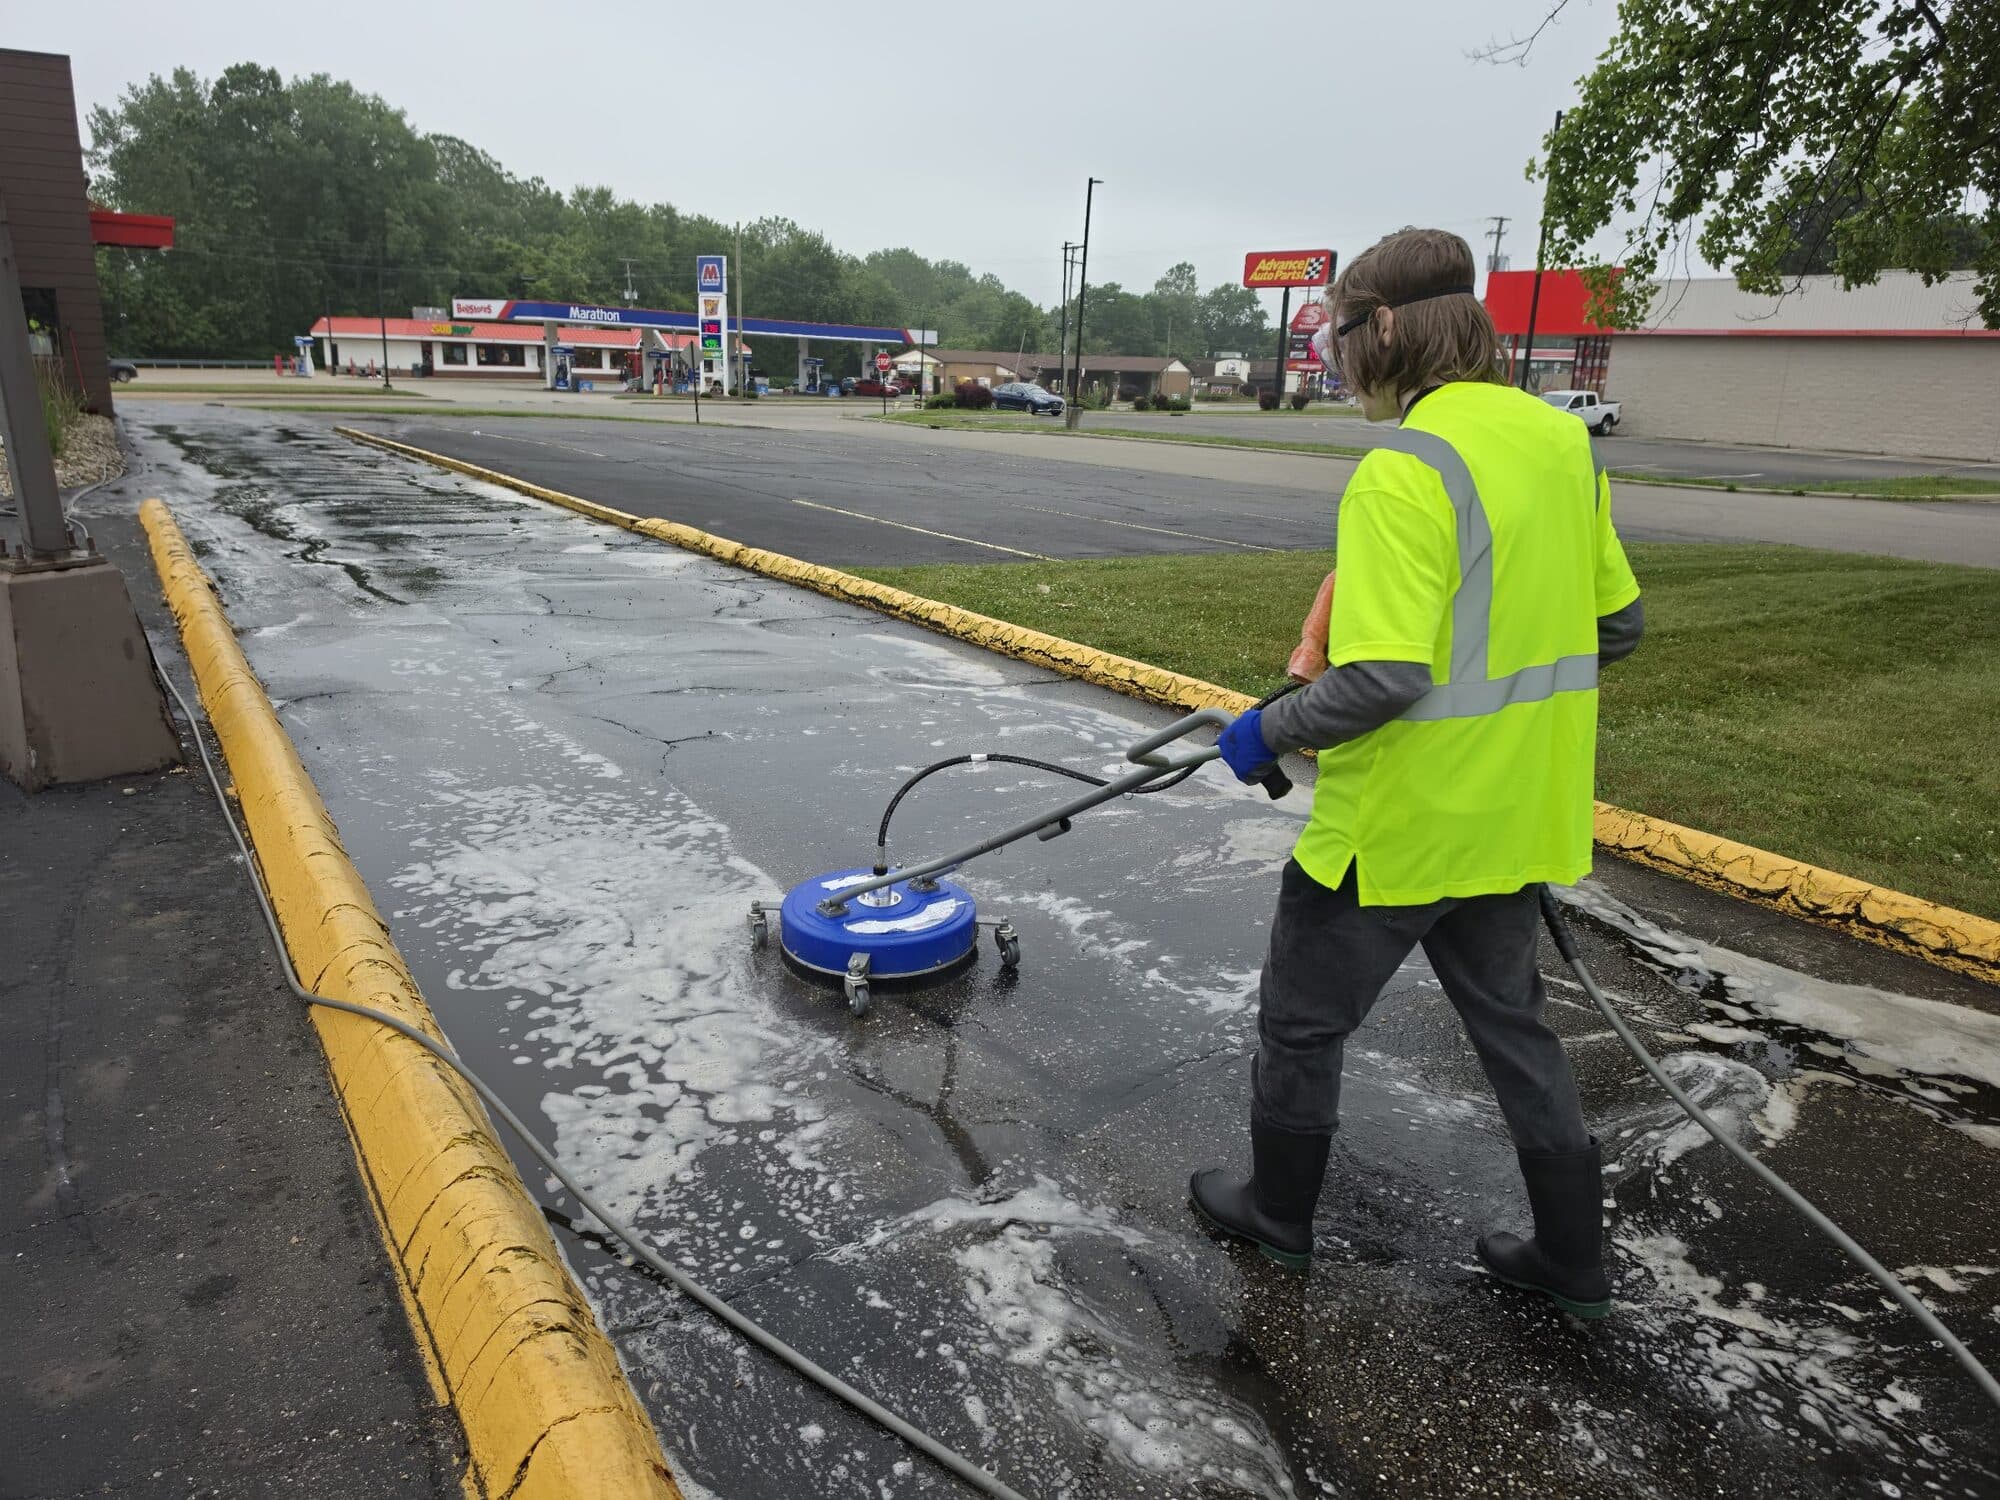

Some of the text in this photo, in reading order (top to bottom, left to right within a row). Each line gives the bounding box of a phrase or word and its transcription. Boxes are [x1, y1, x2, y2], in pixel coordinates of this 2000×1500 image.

[1256, 258, 1305, 271] Advance
[1248, 270, 1302, 281] Auto Parts
[569, 306, 620, 321] Marathon
[876, 357, 890, 366] STOP
